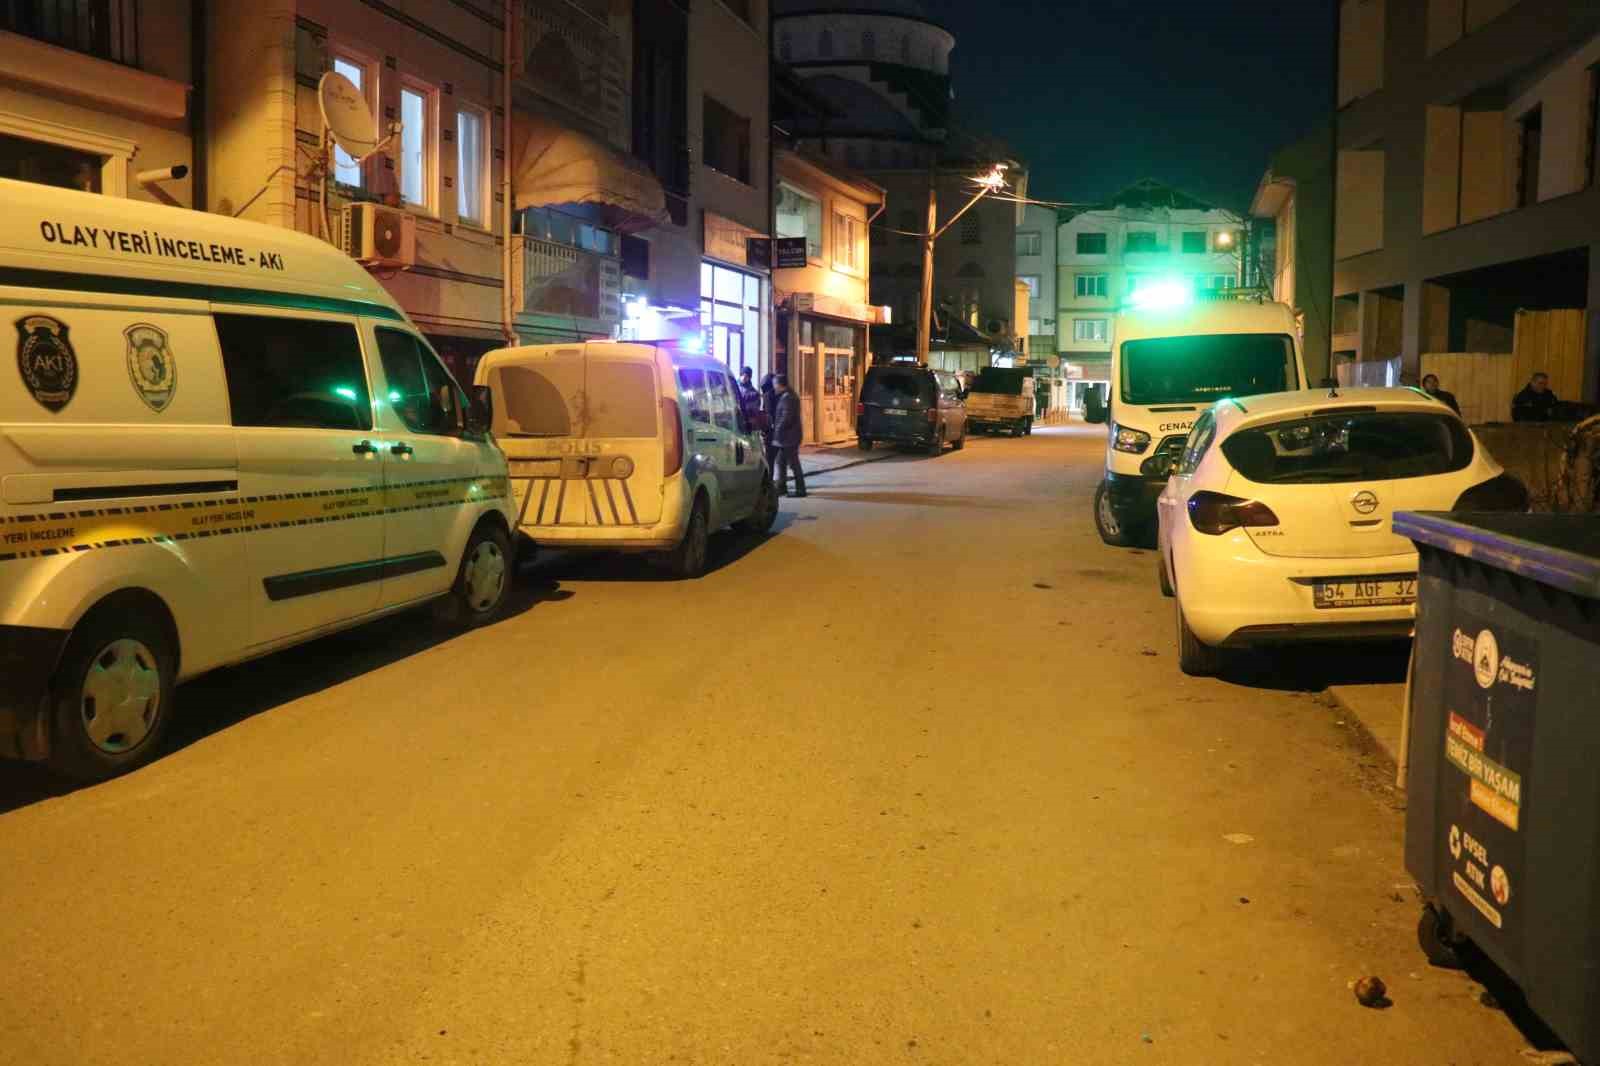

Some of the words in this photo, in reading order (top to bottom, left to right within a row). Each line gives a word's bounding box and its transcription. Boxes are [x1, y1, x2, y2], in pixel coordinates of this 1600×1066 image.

[40, 220, 99, 249] OLAY
[103, 229, 152, 255] YERİ
[156, 231, 246, 266] İNCELEME
[1325, 582, 1344, 599] 54
[1354, 580, 1382, 597] AGF
[1483, 761, 1520, 804] YAŞAM
